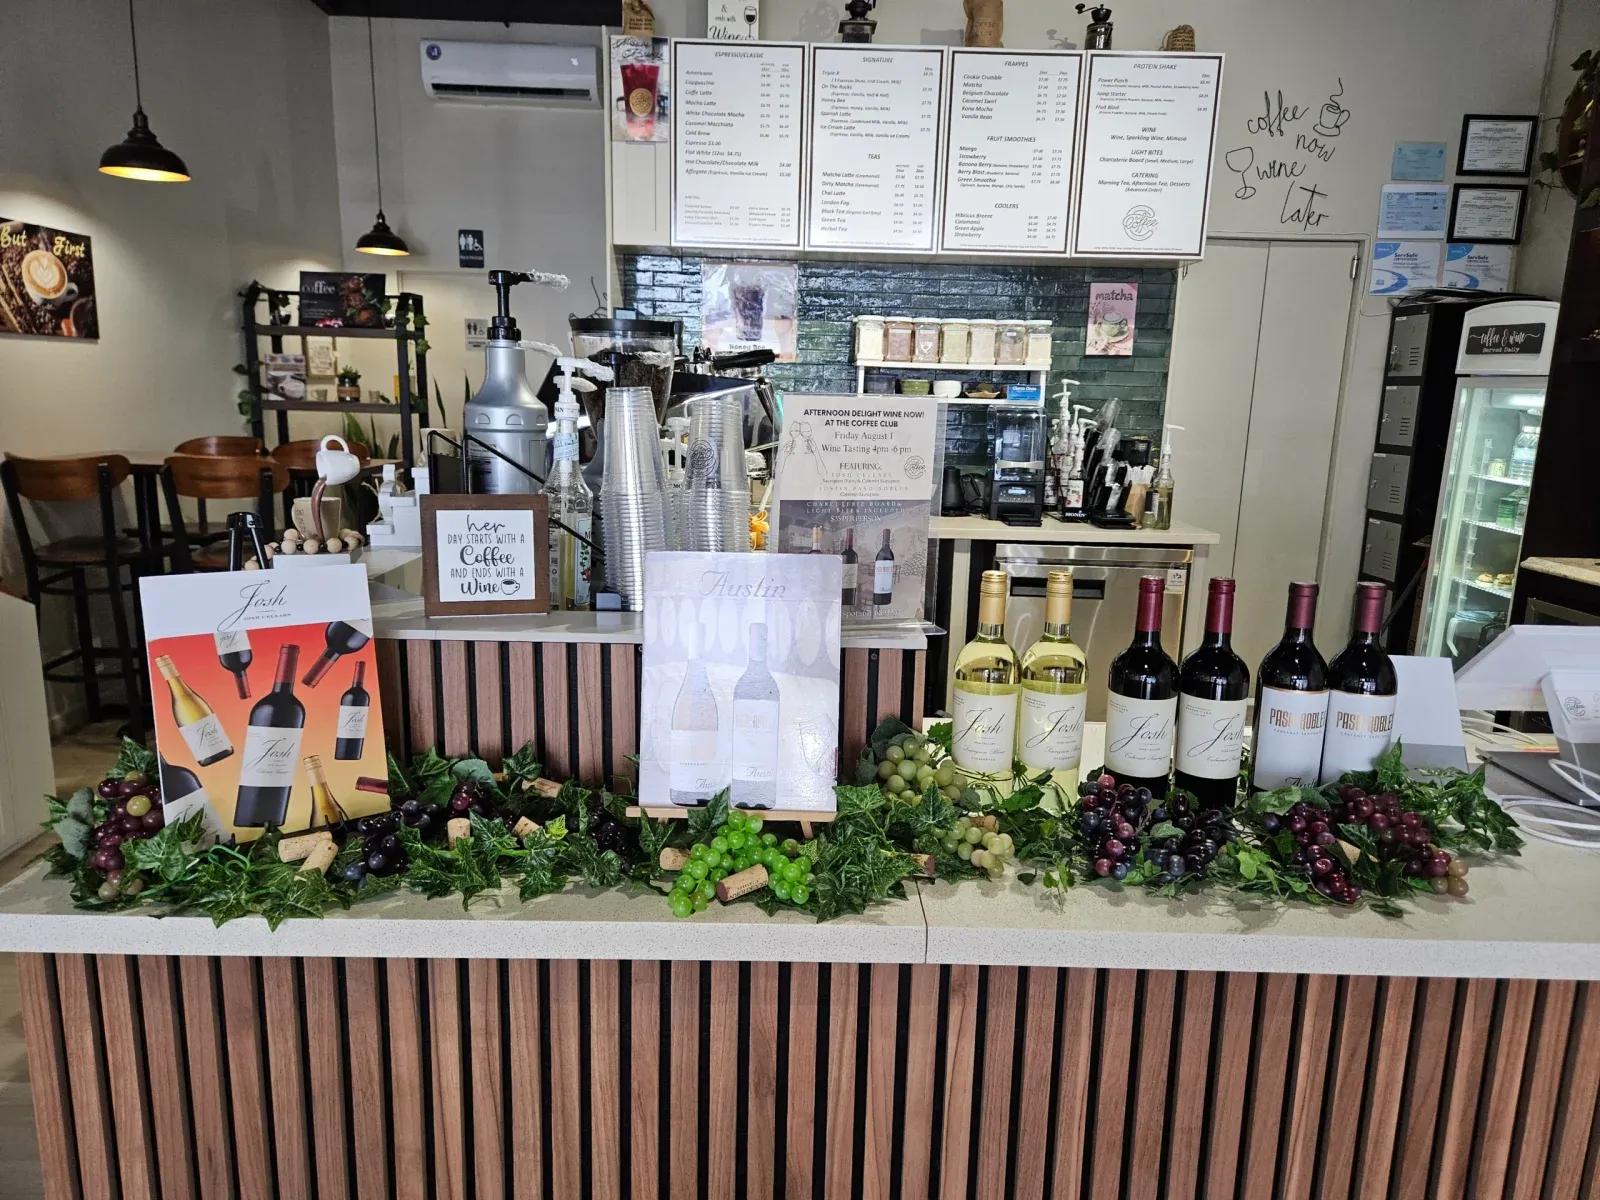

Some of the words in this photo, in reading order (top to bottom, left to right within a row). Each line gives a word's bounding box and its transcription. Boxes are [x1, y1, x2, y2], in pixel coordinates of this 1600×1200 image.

[721, 4, 728, 12] &
[709, 26, 742, 40] Wine
[1247, 90, 1310, 137] coffee
[1296, 134, 1335, 162] now
[1256, 160, 1306, 180] wine
[1, 226, 27, 248] But
[53, 236, 85, 257] First
[302, 281, 336, 294] coffee
[1096, 289, 1133, 301] matcha
[1480, 328, 1500, 346] coffee
[1501, 329, 1509, 346] &
[1509, 331, 1526, 344] wine
[852, 410, 882, 418] DELIGHT
[835, 431, 858, 441] Friday
[861, 432, 887, 441] August
[822, 444, 842, 452] Wine
[844, 445, 870, 454] Tasting
[872, 445, 889, 454] 4pm
[839, 463, 882, 471] FEATURING:
[467, 514, 505, 533] her
[448, 534, 462, 544] DAY
[467, 534, 492, 544] STARTS
[496, 534, 516, 544] WITH
[520, 534, 525, 543] A
[460, 545, 515, 567] Coffee
[451, 568, 467, 578] AND
[472, 568, 491, 578] ENDS
[496, 568, 515, 577] WITH
[520, 567, 524, 577] A
[461, 578, 500, 595] Wine
[699, 570, 788, 599] Austin
[217, 580, 287, 632] Josh
[342, 712, 365, 731] Josh
[953, 708, 1006, 744] Josh
[1026, 706, 1083, 748] Josh
[1270, 708, 1295, 727] PASO
[1337, 711, 1362, 730] PASO
[196, 721, 219, 749] Josh
[1110, 713, 1170, 752] Josh
[1188, 713, 1244, 757] Josh
[244, 736, 295, 771] Josh
